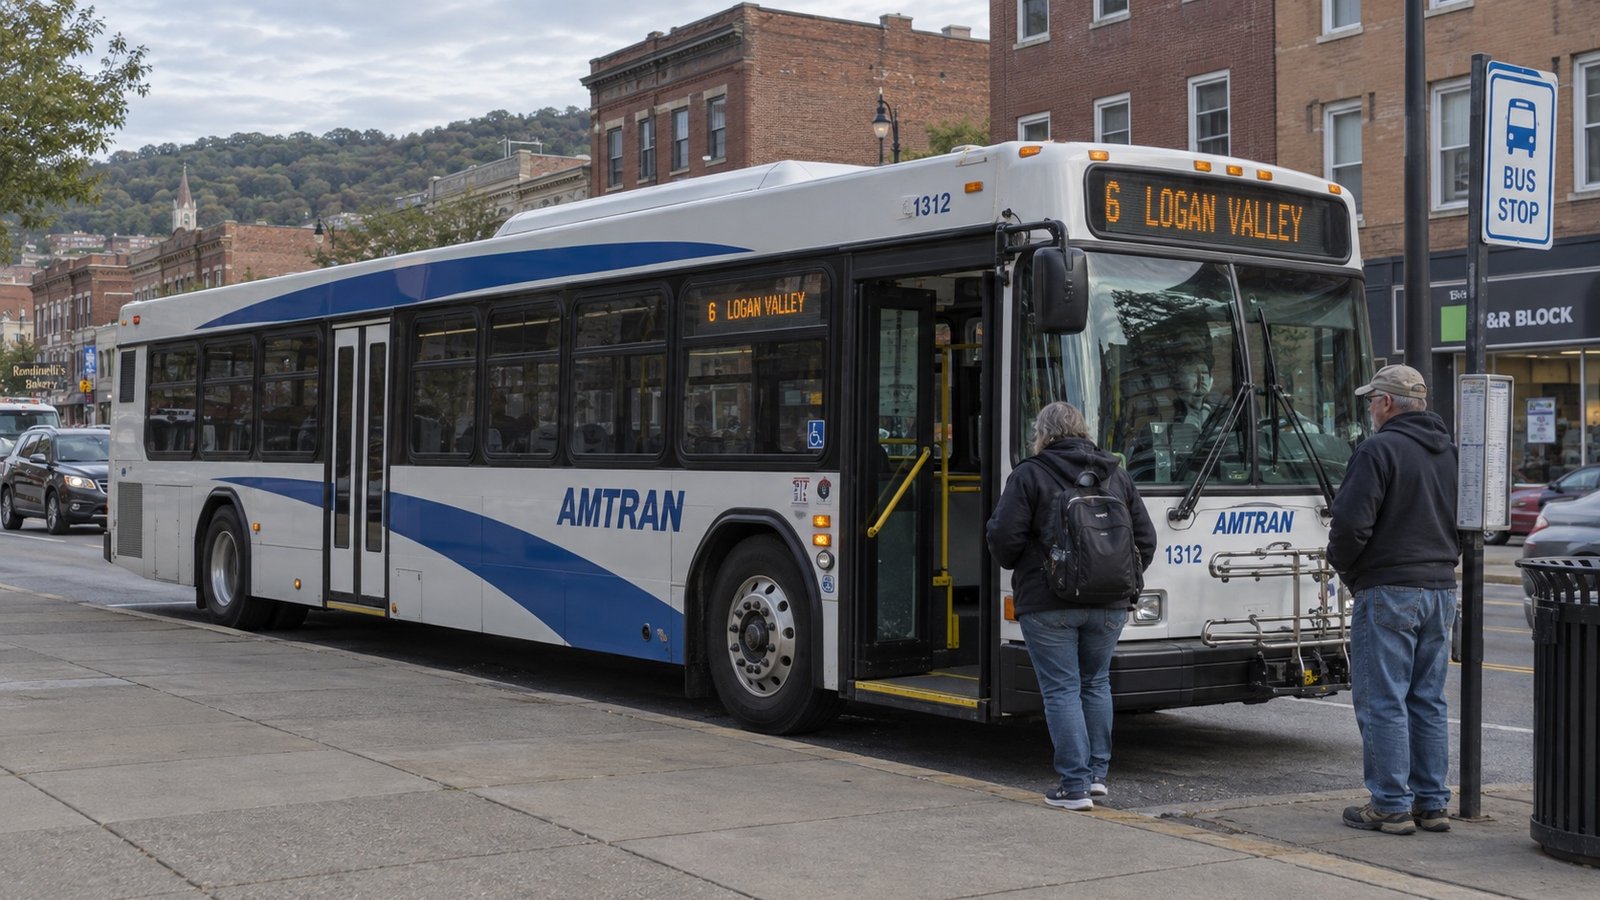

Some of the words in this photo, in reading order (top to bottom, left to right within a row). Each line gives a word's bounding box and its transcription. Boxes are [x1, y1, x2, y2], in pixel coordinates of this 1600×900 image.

[1503, 165, 1536, 193] BUS
[913, 192, 951, 217] 1312
[1105, 180, 1121, 223] 6
[1146, 186, 1216, 233] LOGAN
[1228, 197, 1303, 242] VALLEY
[1498, 197, 1539, 225] STOP
[708, 302, 716, 322] 6
[727, 297, 761, 320] LOGAN
[765, 291, 806, 316] VALLEY
[1515, 306, 1574, 327] BLOCK
[556, 487, 686, 533] AMTRAN
[1212, 510, 1295, 535] AMTRAN
[1165, 544, 1203, 565] 1312
